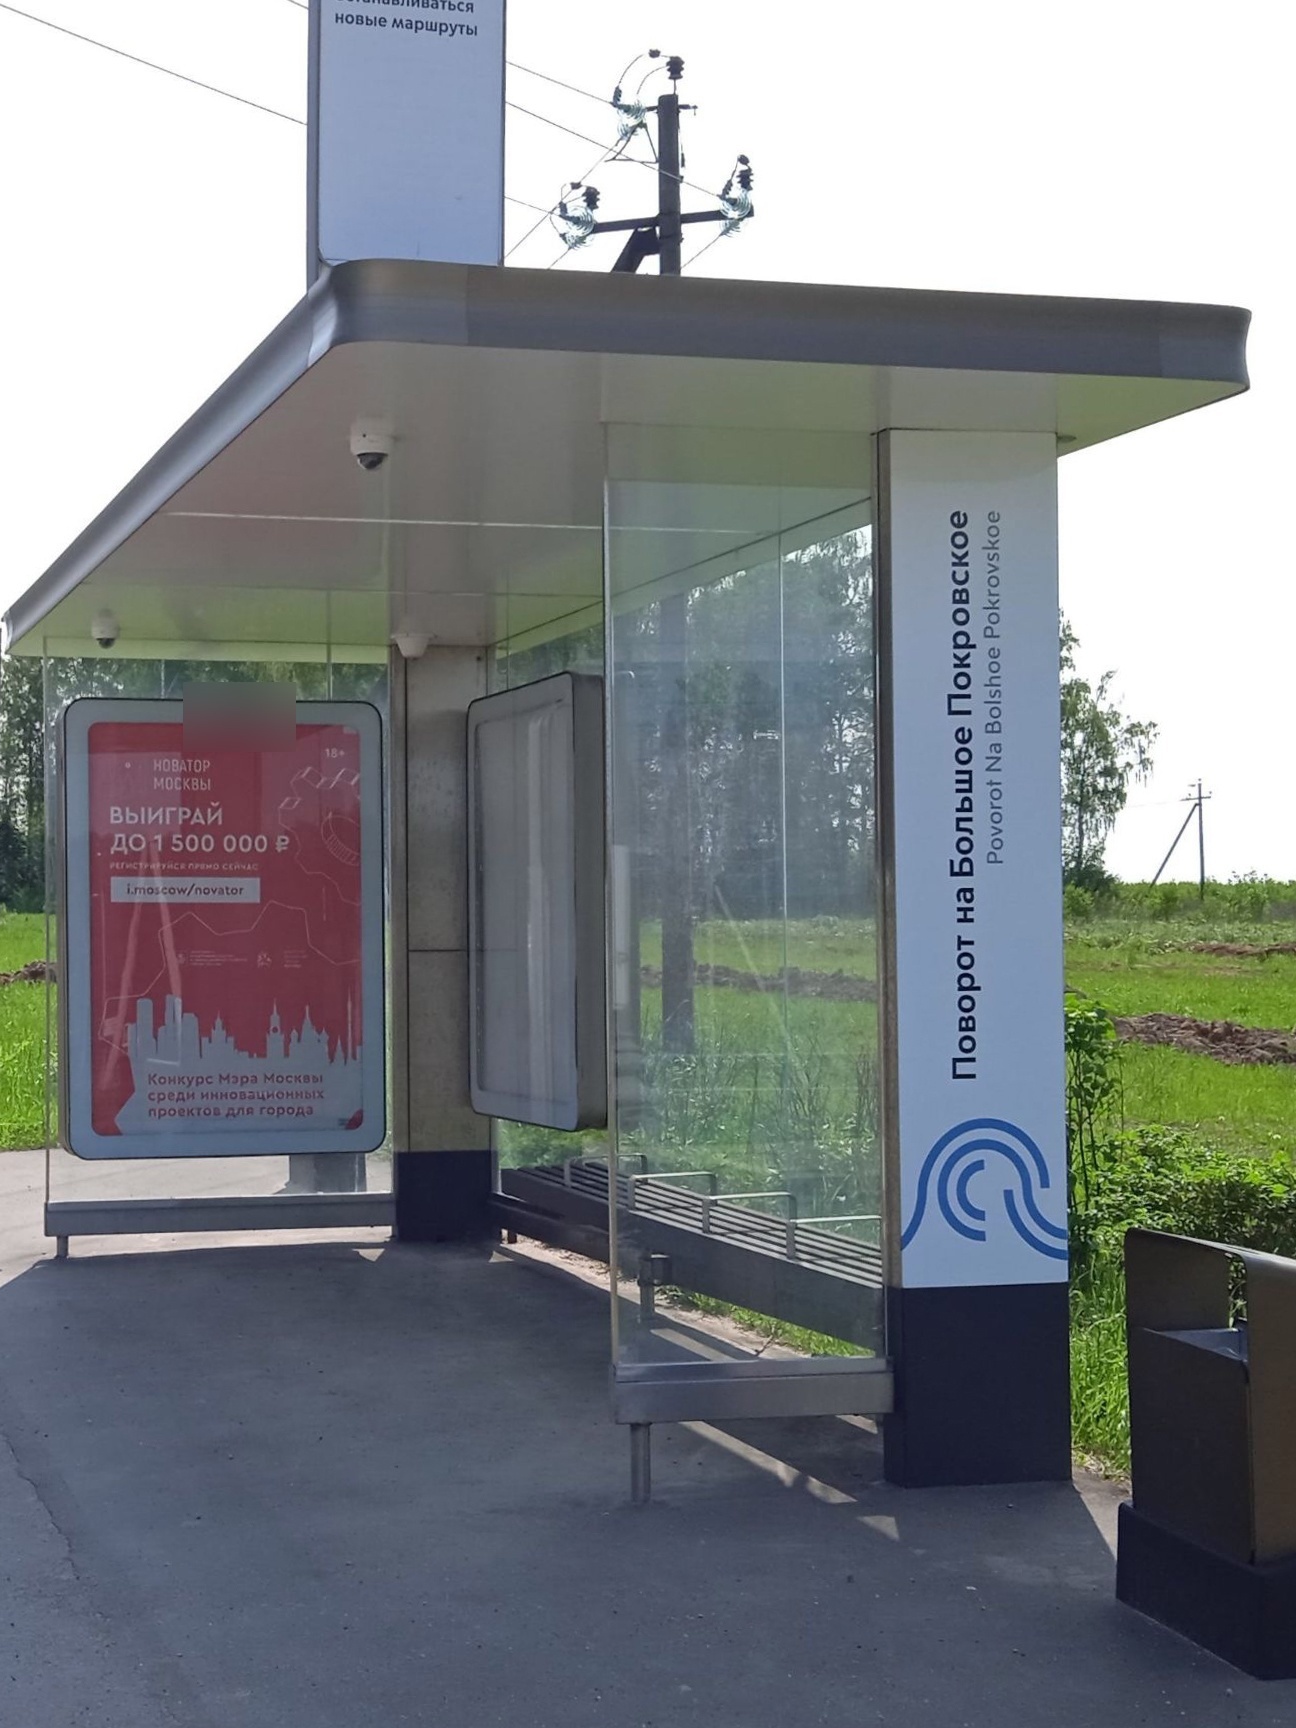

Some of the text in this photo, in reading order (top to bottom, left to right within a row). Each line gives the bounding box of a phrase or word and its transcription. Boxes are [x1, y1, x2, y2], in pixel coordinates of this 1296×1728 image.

[335, 12, 478, 37] новые маршруты
[982, 510, 1004, 864] Povorot Na Bolshoe Pokrovskoe
[325, 747, 345, 758] 18+
[154, 759, 211, 773] НОВАТОР
[154, 777, 211, 791] МОСКВЫ
[947, 510, 982, 1079] Поворот на Большое Покровское
[109, 801, 223, 826] ВЫИГРАЙ
[110, 833, 147, 855] ДО
[171, 834, 215, 853] 500
[223, 834, 268, 853] 000
[127, 883, 245, 897] i.moscow/novator
[148, 1073, 324, 1088] Конкурс Мэра Москвы
[148, 1090, 325, 1102] среди инновационных
[148, 1105, 315, 1120] проектов для города
